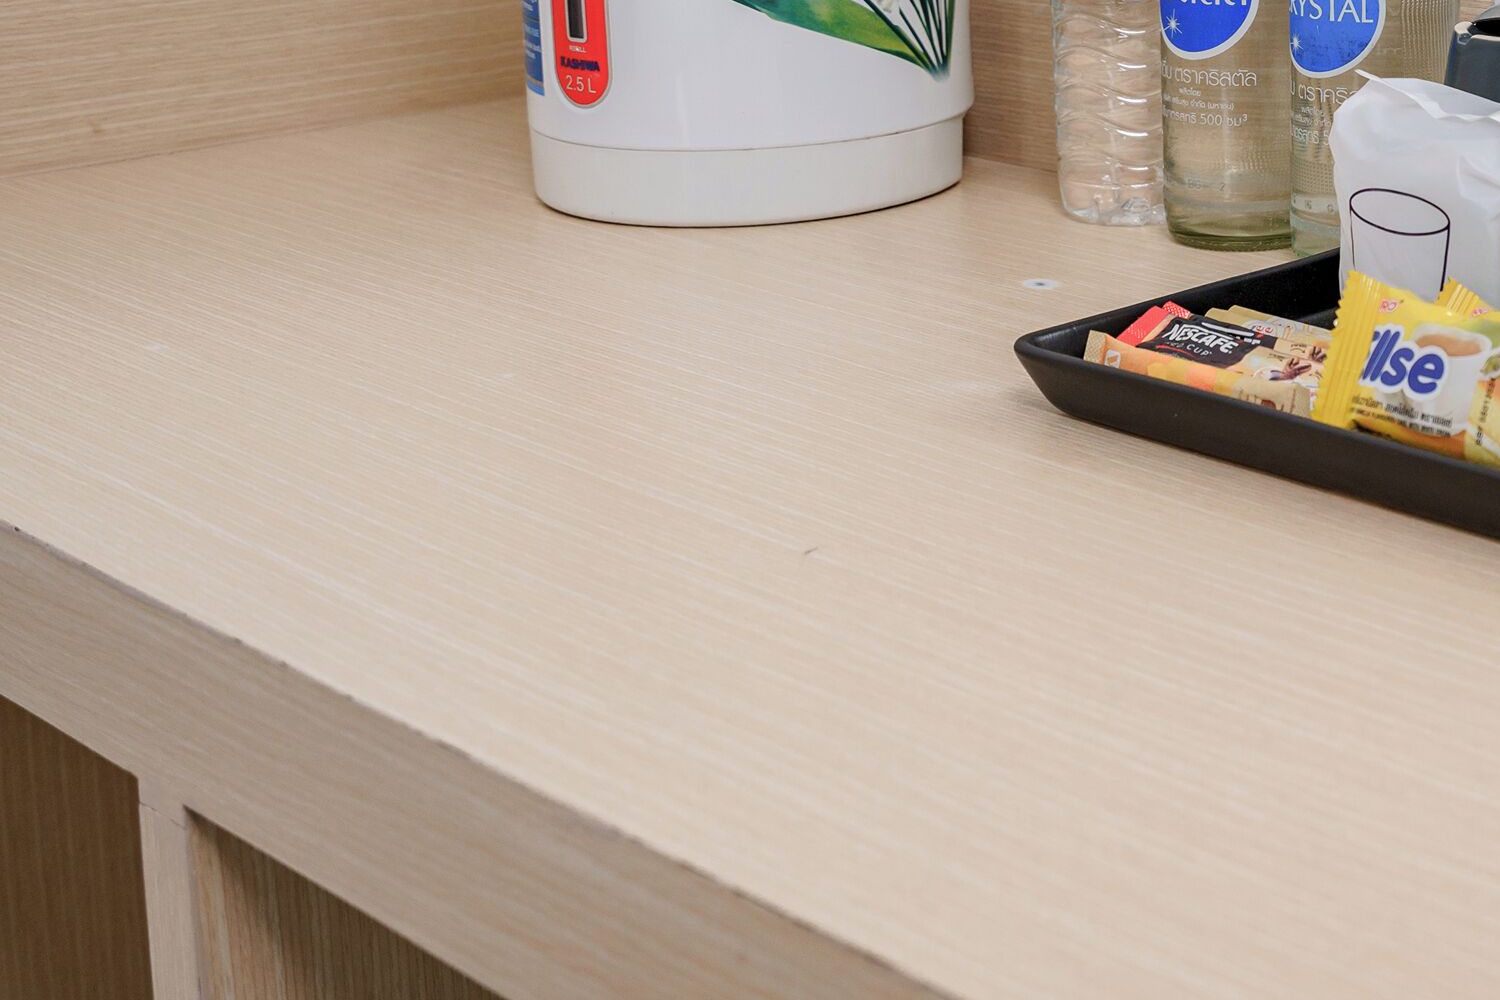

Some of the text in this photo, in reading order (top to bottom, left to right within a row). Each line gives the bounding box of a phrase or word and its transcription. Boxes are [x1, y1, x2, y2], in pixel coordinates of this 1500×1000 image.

[565, 73, 598, 95] 2.5 L
[1174, 68, 1258, 87] ตราคริสตัล
[1200, 112, 1223, 126] 500
[1360, 329, 1445, 394] llse
